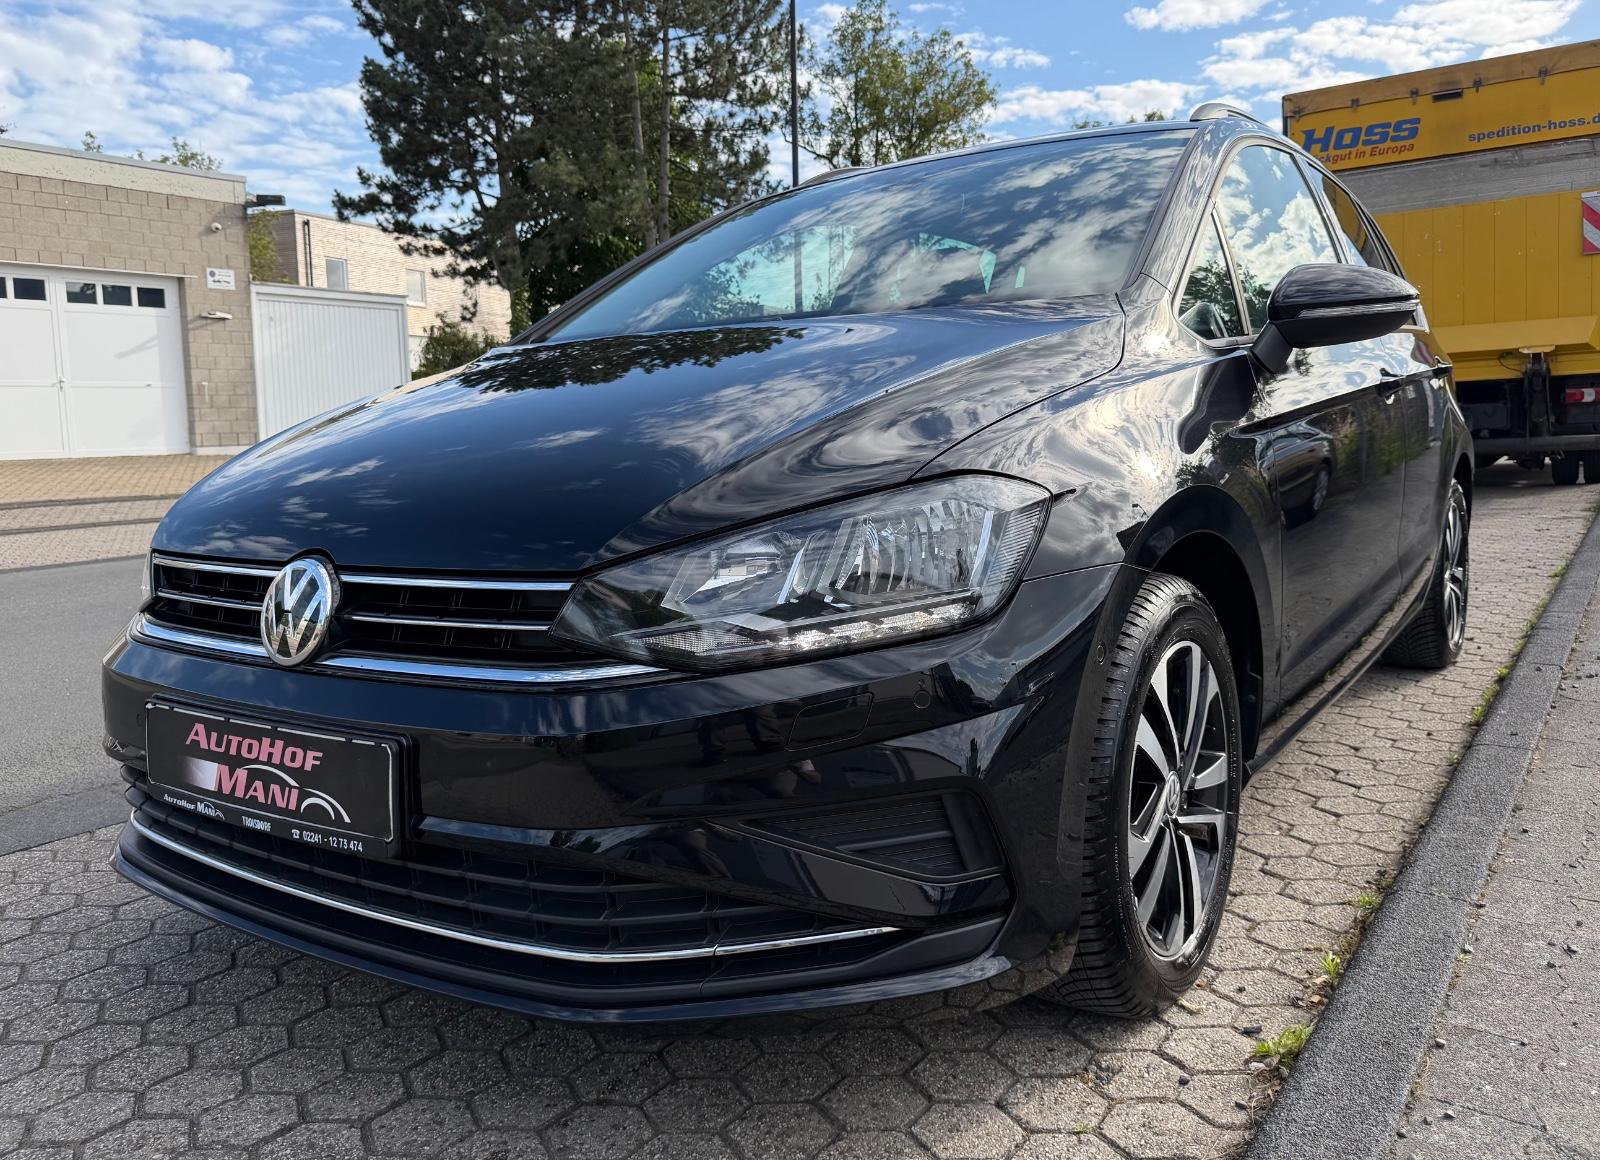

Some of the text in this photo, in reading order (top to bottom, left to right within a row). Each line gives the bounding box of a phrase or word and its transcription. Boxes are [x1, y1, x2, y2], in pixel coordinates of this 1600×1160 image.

[1354, 147, 1366, 160] in
[1369, 143, 1414, 158] Europa
[241, 815, 272, 832] TROISDORF
[302, 830, 322, 844] 02241
[328, 836, 338, 848] 12
[339, 838, 348, 849] 73
[349, 840, 363, 853] 474
